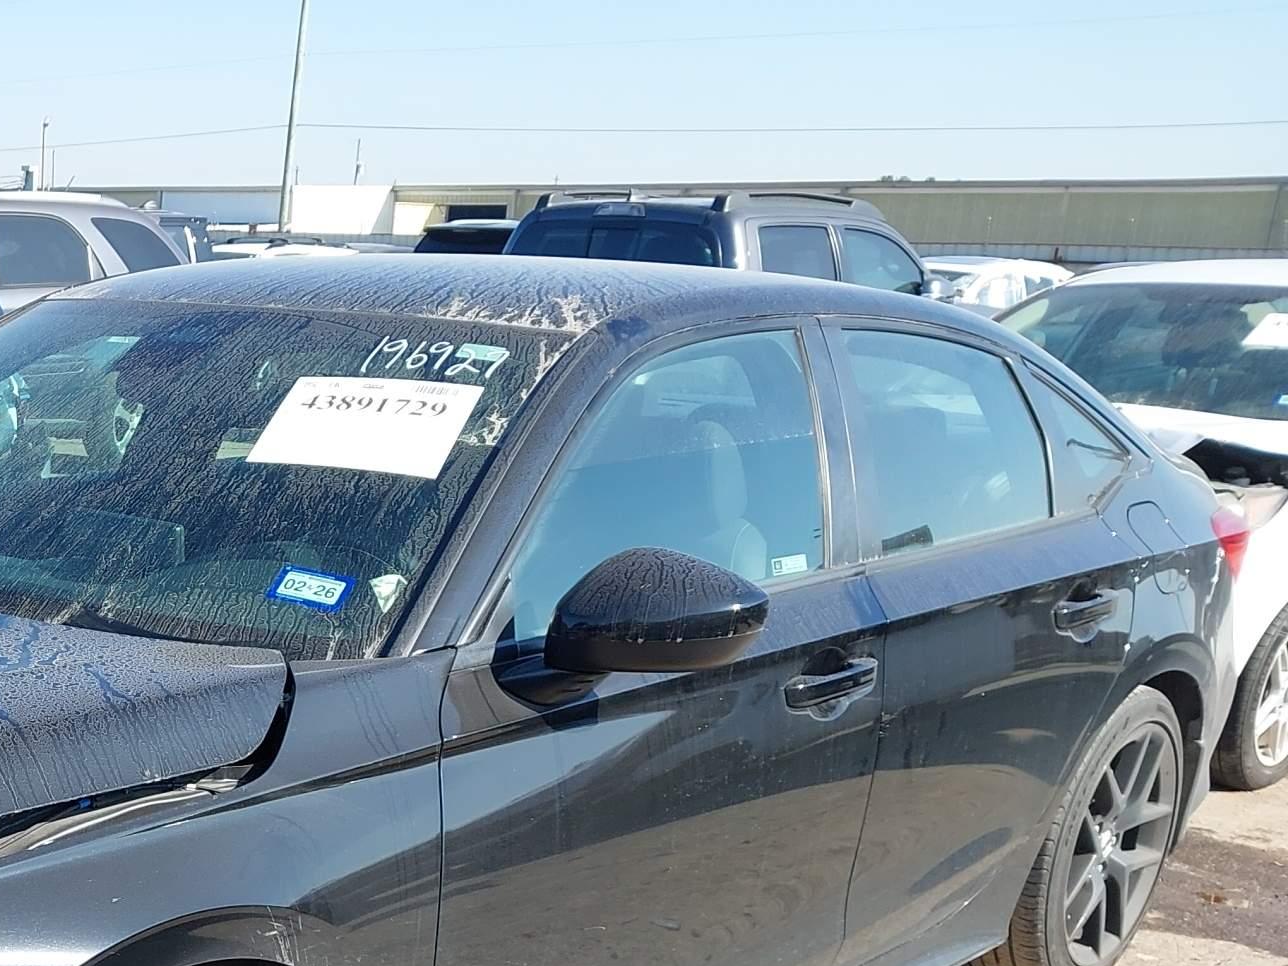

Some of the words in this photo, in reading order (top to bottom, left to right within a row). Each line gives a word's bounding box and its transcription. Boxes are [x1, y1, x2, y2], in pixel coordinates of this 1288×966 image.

[300, 393, 448, 417] 43891729
[283, 578, 307, 593] 02
[313, 584, 337, 600] 26
